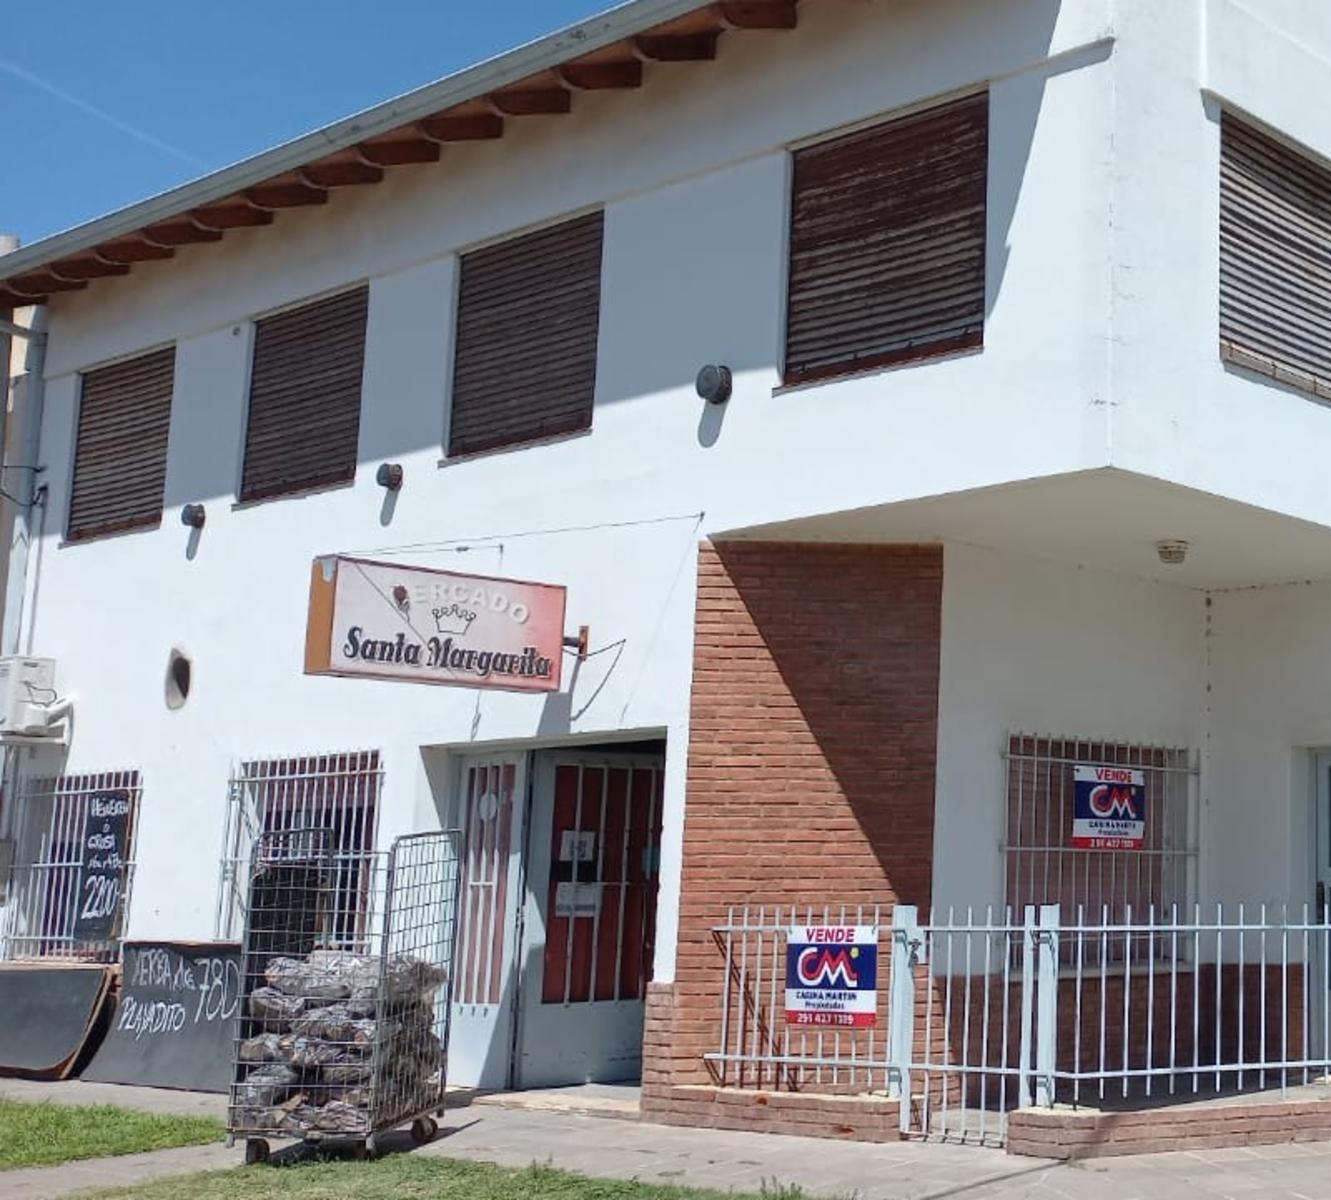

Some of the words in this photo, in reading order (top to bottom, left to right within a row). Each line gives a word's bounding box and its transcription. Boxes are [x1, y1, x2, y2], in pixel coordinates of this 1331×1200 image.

[392, 582, 530, 625] ERCADO
[343, 626, 421, 666] Santa
[426, 636, 553, 678] Margarita
[1095, 768, 1132, 783] VENDE
[806, 928, 856, 943] VENDE
[825, 991, 857, 1001] MARTIN
